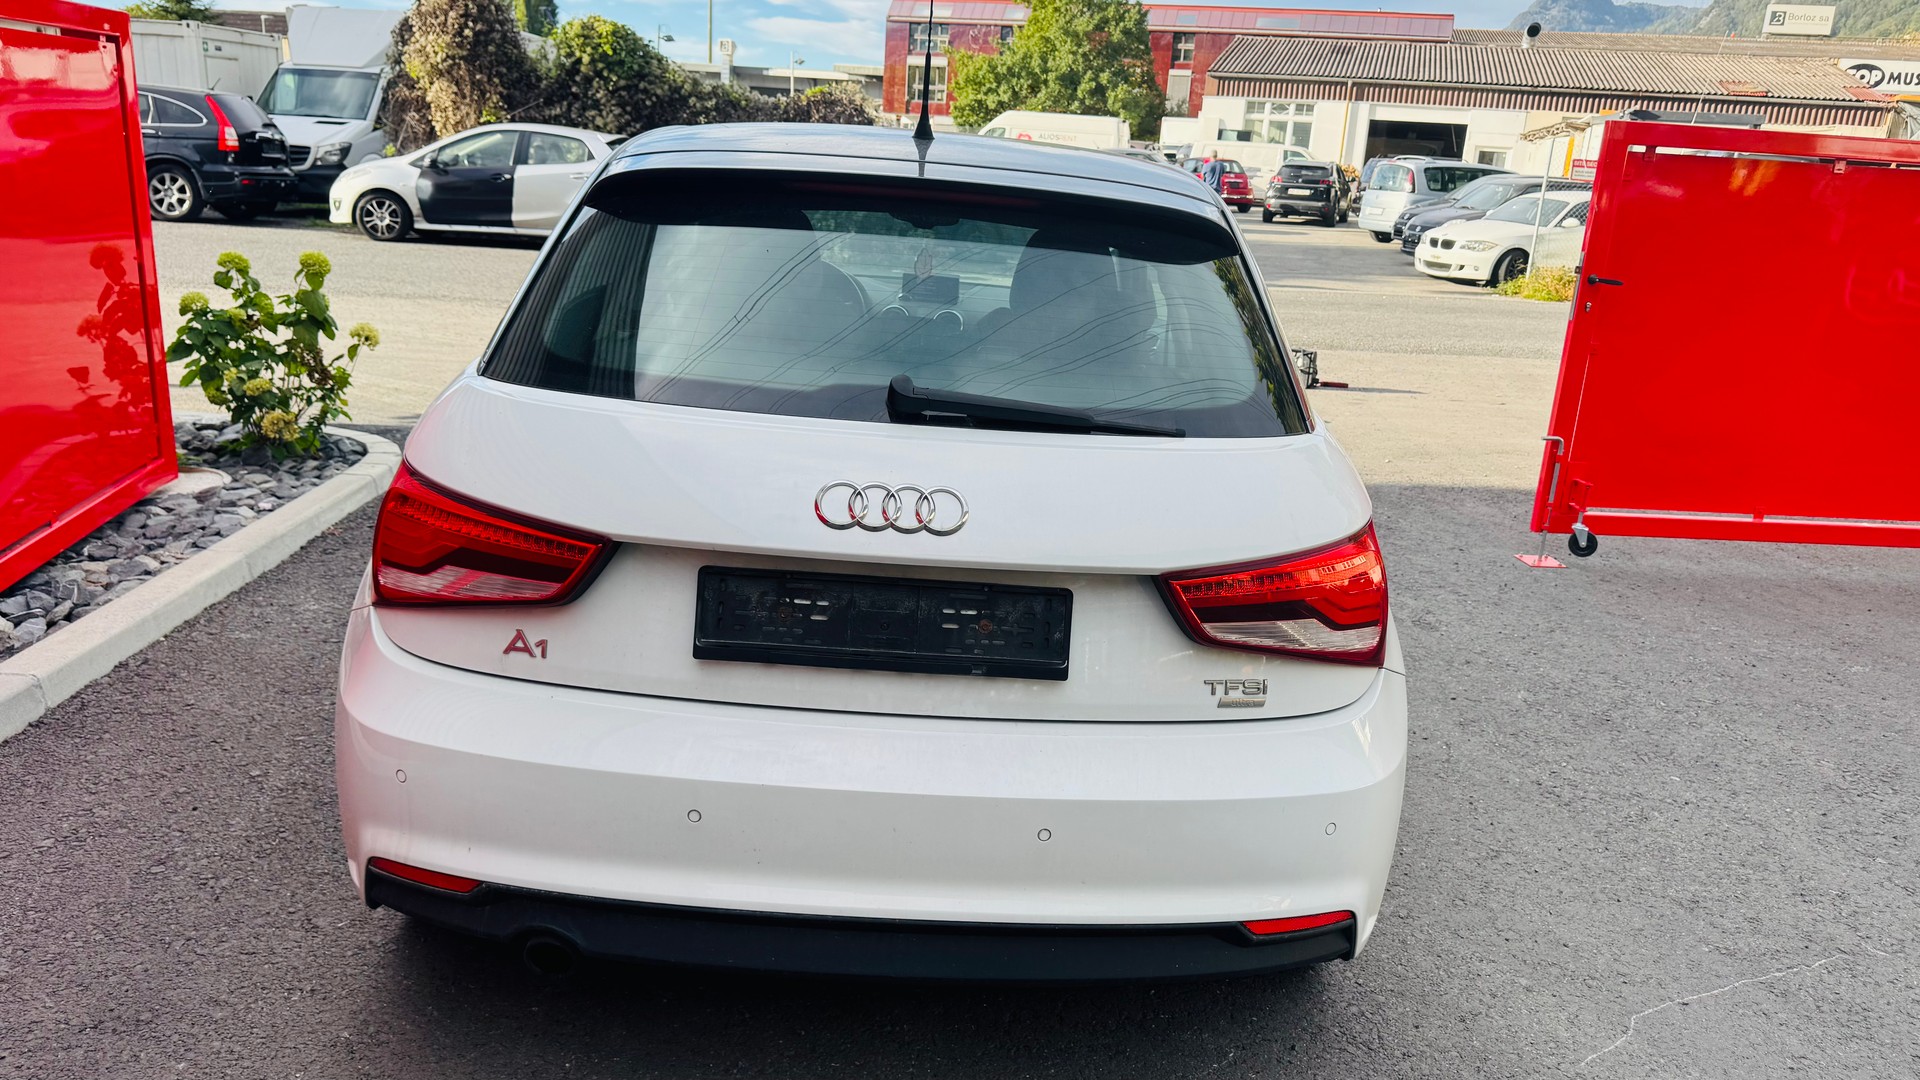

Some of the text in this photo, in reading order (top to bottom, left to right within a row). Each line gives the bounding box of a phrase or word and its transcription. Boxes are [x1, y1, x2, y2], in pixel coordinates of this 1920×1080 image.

[1788, 12, 1817, 22] Borloz
[502, 628, 548, 659] A1
[1203, 678, 1268, 696] TFSI
